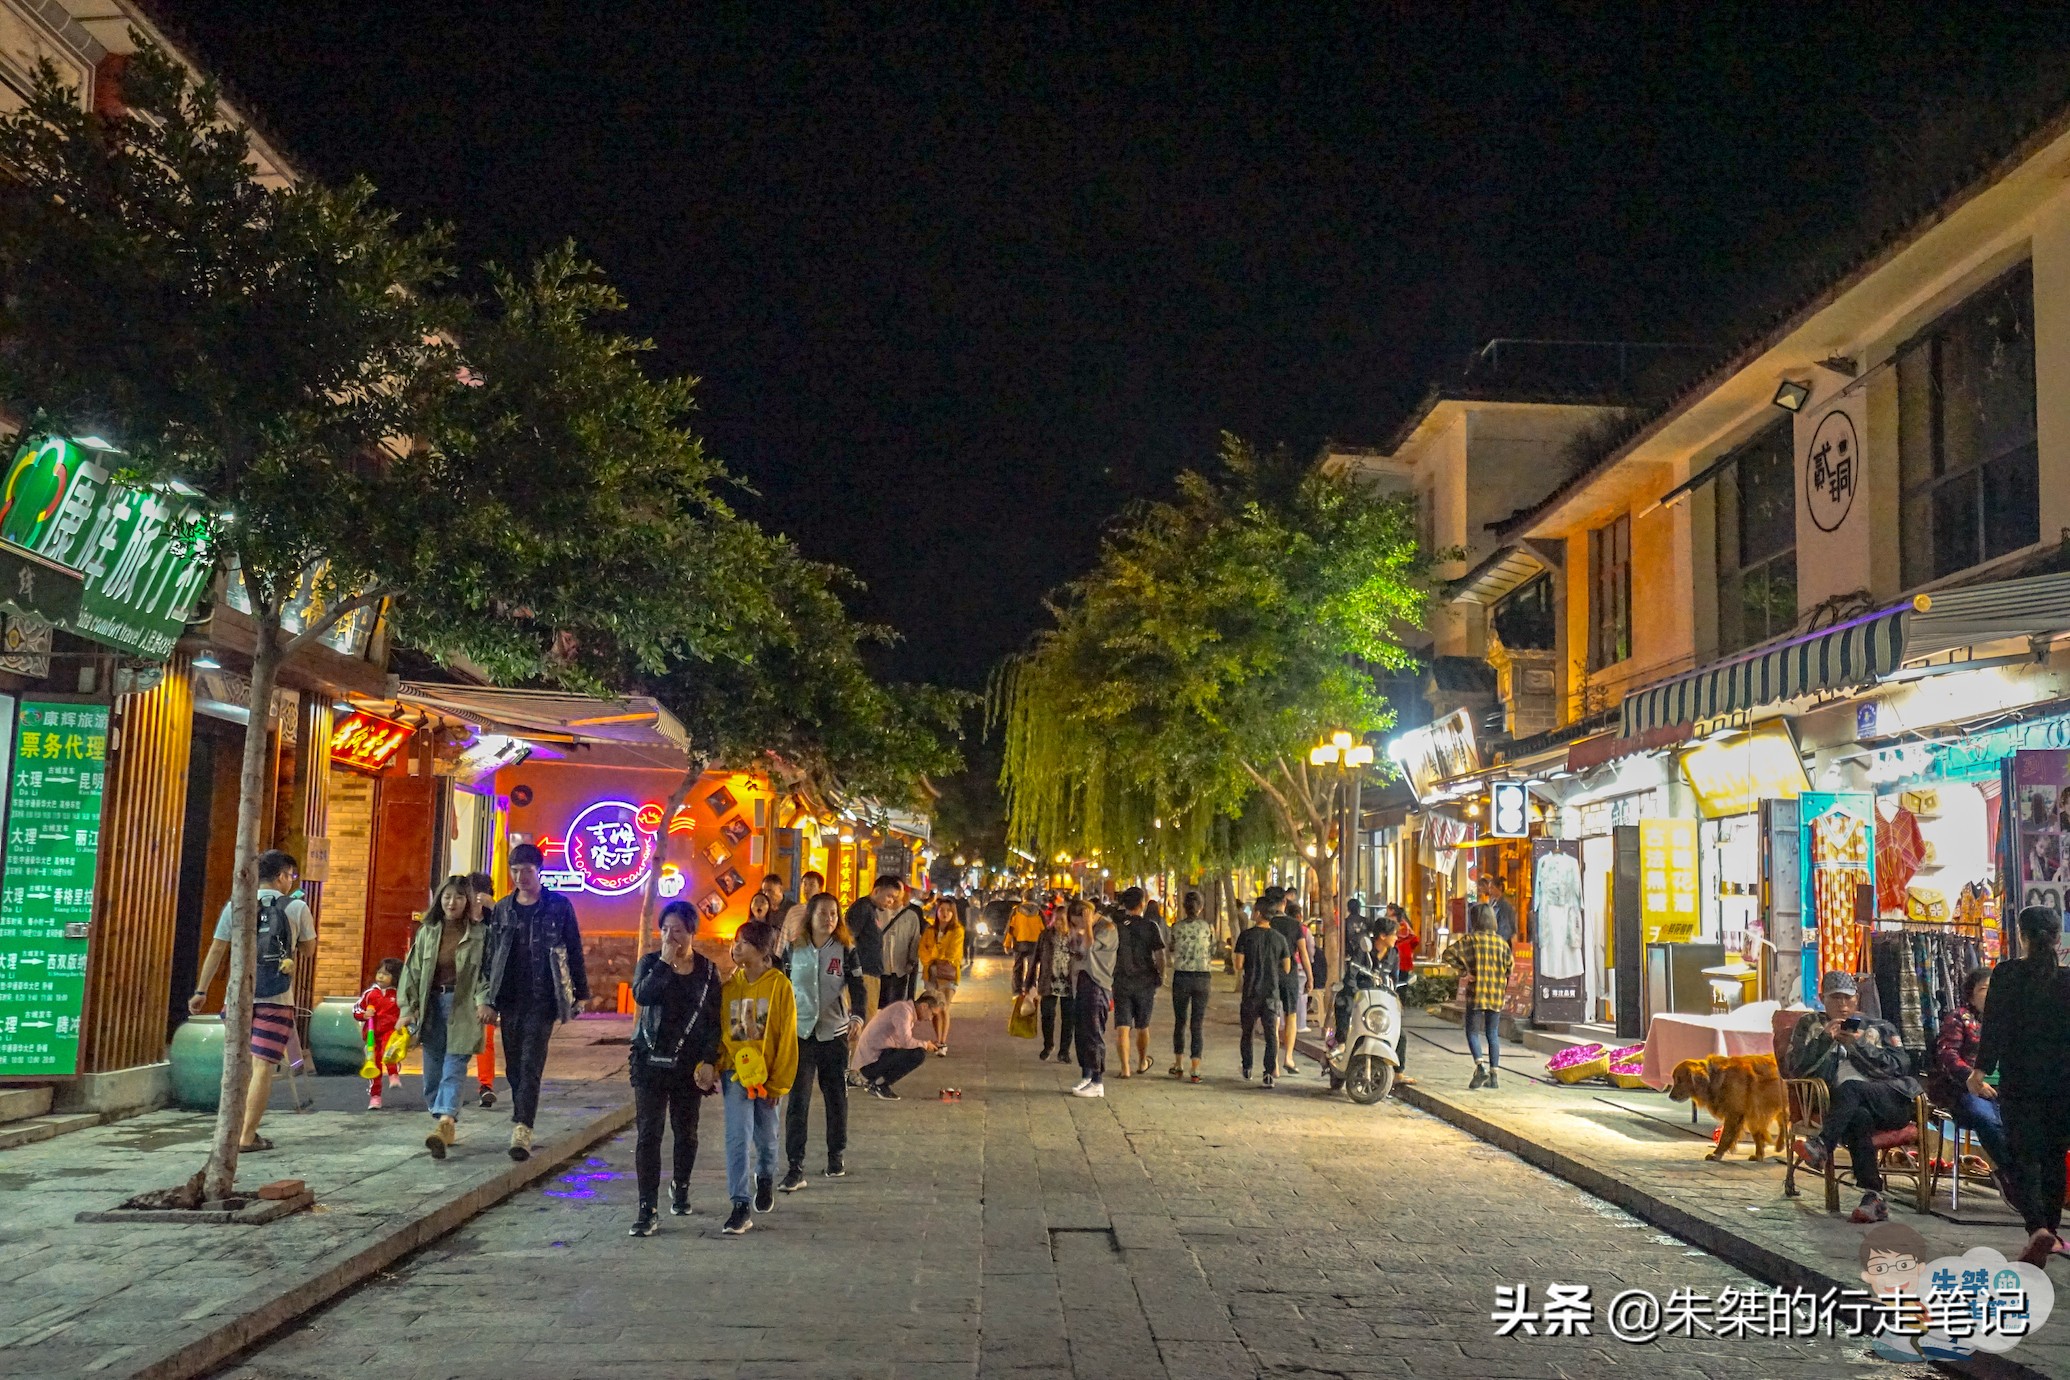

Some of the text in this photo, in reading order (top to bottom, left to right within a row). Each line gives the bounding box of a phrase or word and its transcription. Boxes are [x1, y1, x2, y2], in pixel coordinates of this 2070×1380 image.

[43, 711, 108, 729] 康辉旅游
[21, 731, 105, 760] 票务代理
[16, 770, 43, 788] 大理
[79, 772, 104, 789] 昆明
[11, 827, 37, 844] 大理
[75, 830, 99, 846] 丽江
[3, 887, 24, 904] 大理
[54, 888, 93, 905] 香格里拉
[47, 954, 87, 971] 西双版纳
[56, 1016, 81, 1033] 腾冲
